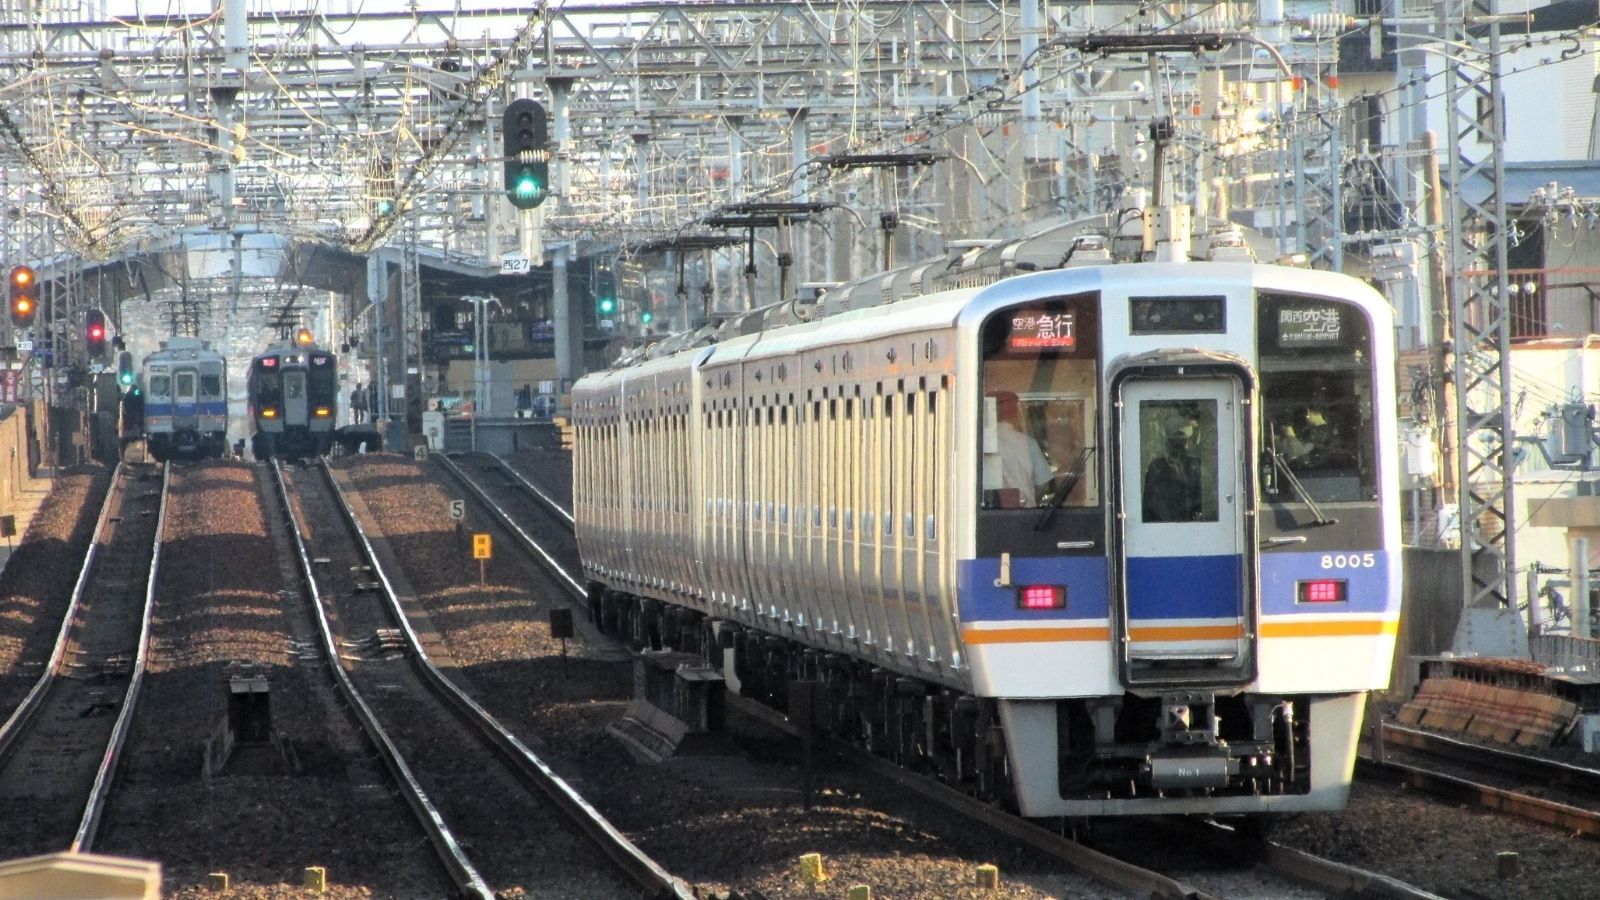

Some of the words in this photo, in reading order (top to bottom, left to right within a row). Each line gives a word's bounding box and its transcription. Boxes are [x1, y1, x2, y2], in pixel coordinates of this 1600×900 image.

[503, 258, 529, 270] 西27
[1012, 314, 1073, 339] 空港急行
[1280, 308, 1340, 332] 関西空港
[452, 502, 463, 518] 5
[1321, 553, 1375, 569] 8005
